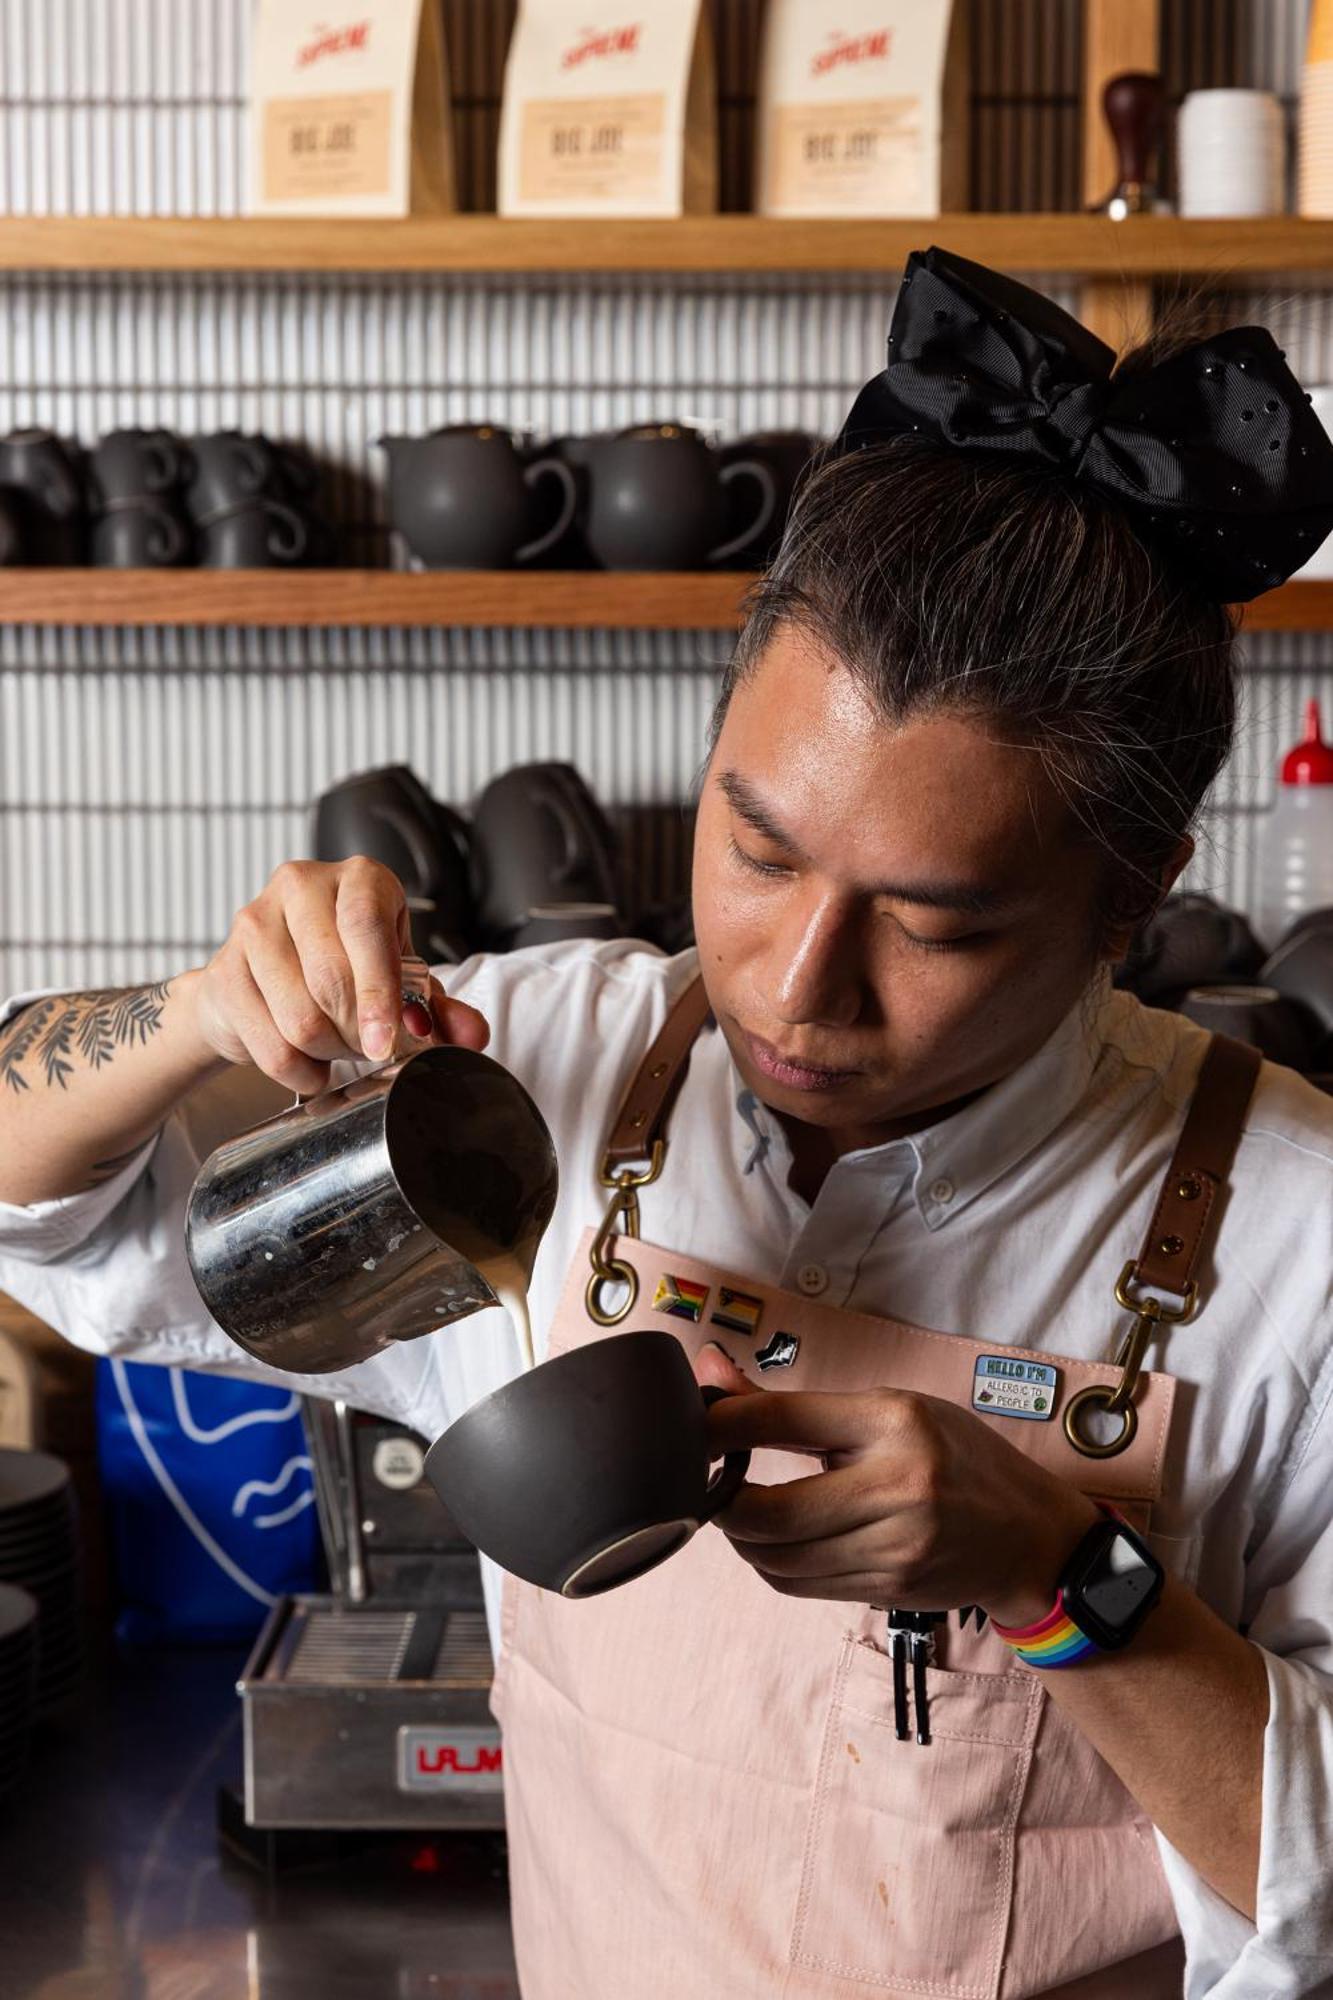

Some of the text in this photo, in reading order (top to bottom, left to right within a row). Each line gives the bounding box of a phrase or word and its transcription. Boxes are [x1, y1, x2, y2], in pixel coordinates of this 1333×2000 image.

[987, 1360, 1047, 1381] HELLO I'M
[987, 1381, 1042, 1397] ALLERGIC TO
[996, 1395, 1030, 1409] PEOPLE
